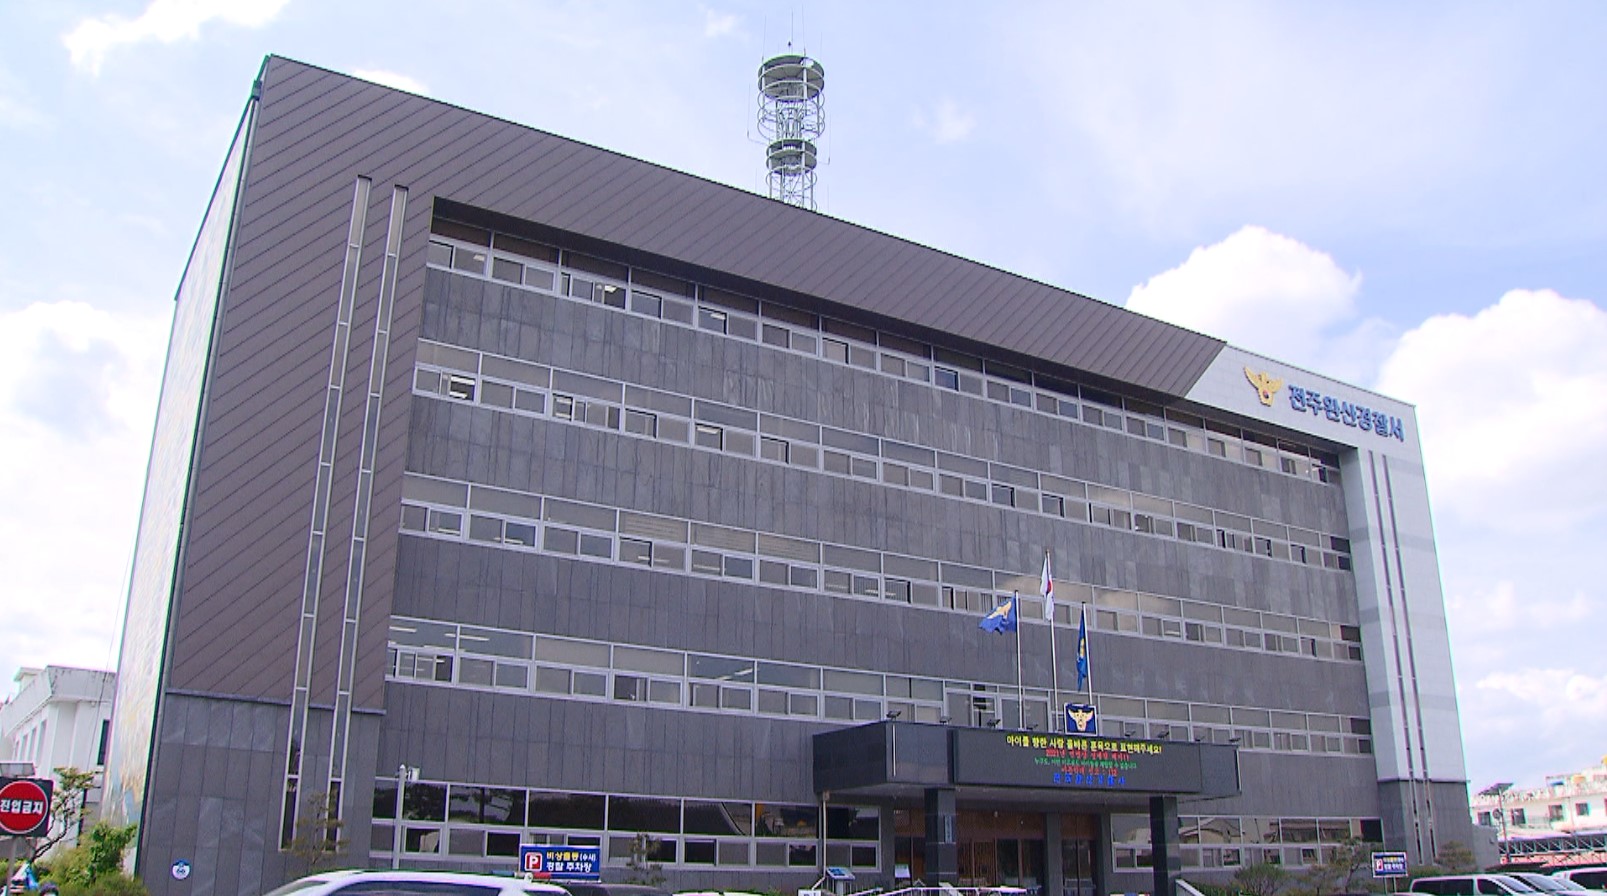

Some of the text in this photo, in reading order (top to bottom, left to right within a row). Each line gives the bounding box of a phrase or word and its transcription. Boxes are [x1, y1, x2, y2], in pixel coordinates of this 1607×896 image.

[1288, 385, 1404, 442] 전주완산경찰서
[0, 799, 43, 815] 진입금지
[529, 855, 538, 869] P
[546, 861, 592, 873] 경찰 주차장
